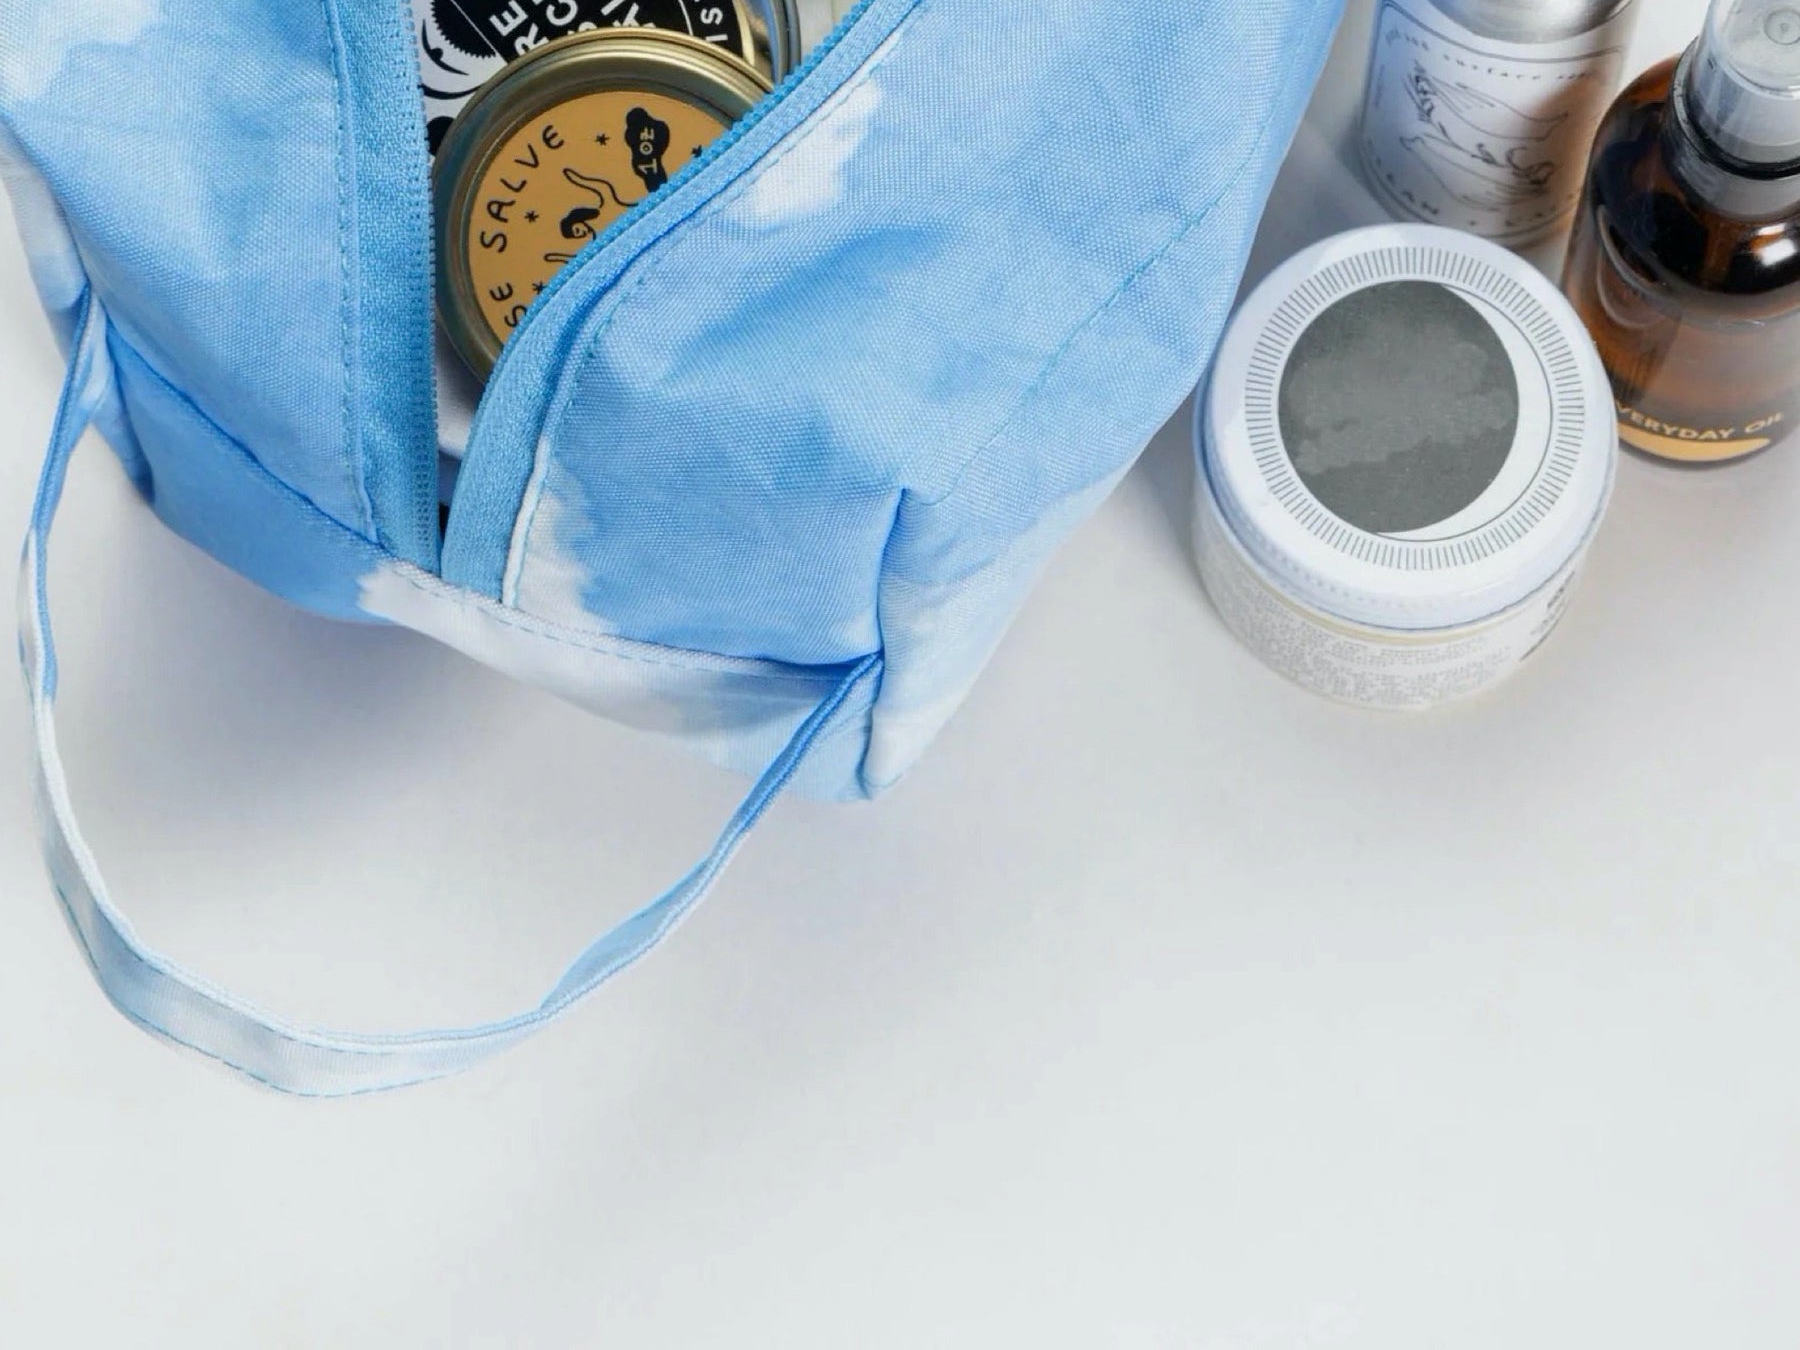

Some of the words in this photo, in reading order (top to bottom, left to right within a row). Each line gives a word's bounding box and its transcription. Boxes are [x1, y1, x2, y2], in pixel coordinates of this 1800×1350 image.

[480, 124, 565, 253] SALVE
[489, 281, 528, 328] SE
[1616, 401, 1735, 440] VERYDAY
[1744, 411, 1785, 434] OIL
